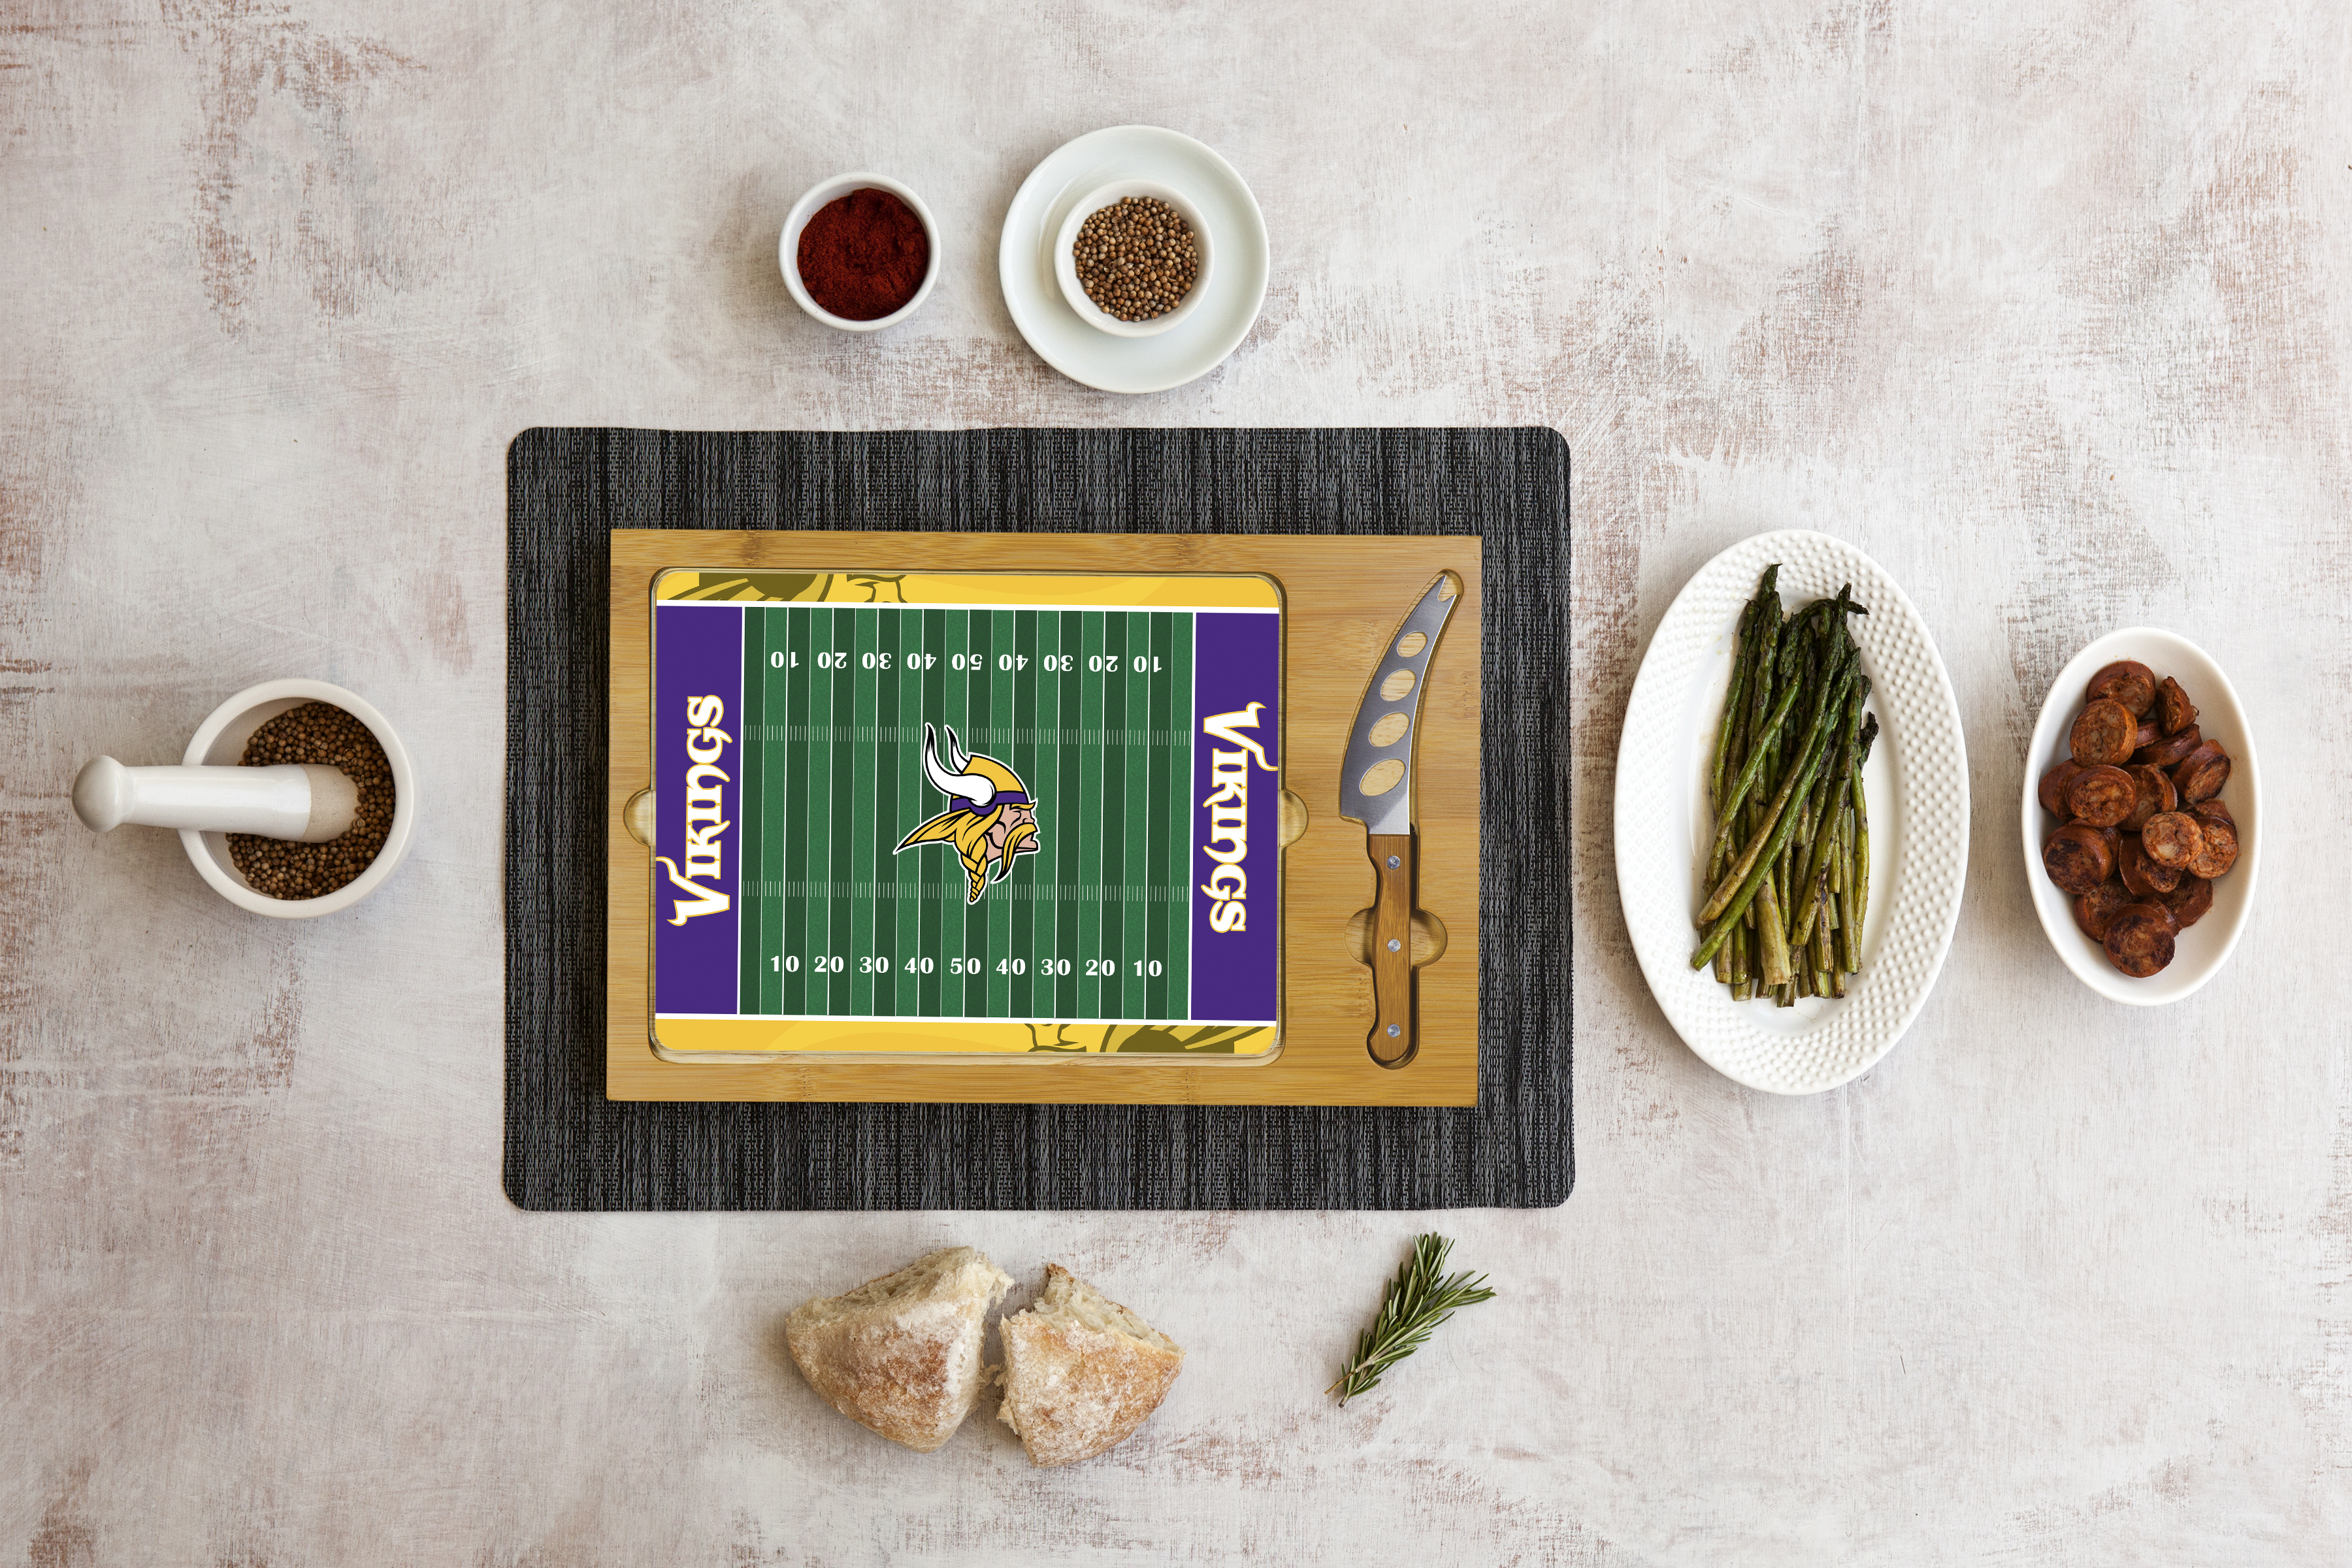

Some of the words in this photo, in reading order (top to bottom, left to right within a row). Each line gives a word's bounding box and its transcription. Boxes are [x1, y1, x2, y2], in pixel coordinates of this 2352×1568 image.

[771, 651, 800, 668] 10
[818, 652, 847, 669] 20
[862, 653, 891, 670] 30
[907, 653, 938, 670] 40
[952, 653, 983, 670] 50
[999, 654, 1029, 671] 40
[1044, 655, 1073, 672] 30
[1089, 655, 1119, 672] 20
[1134, 656, 1163, 673] 10
[771, 955, 800, 972] 10
[815, 956, 845, 973] 20
[859, 956, 890, 973] 30
[905, 957, 935, 974] 40
[951, 958, 981, 975] 50
[996, 958, 1026, 975] 40
[1041, 958, 1071, 976] 30
[1086, 959, 1116, 976] 20
[1134, 960, 1163, 977] 10
